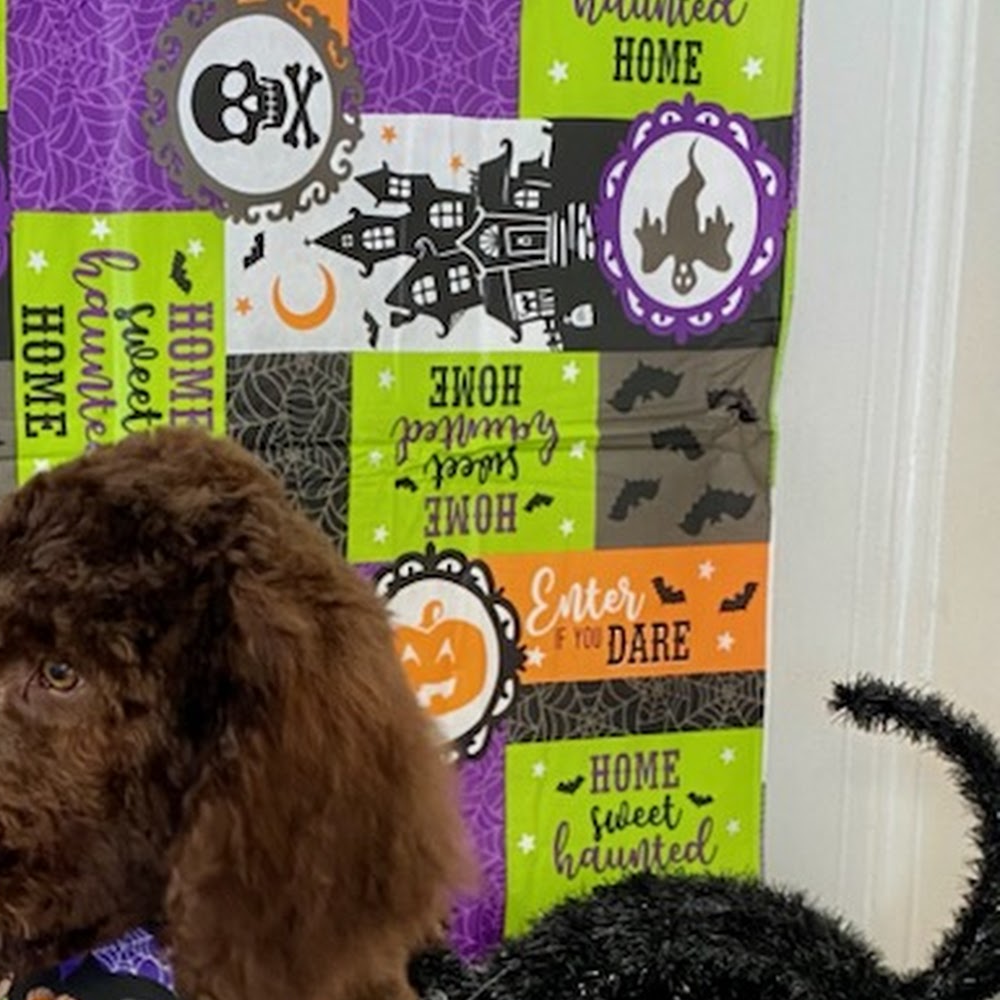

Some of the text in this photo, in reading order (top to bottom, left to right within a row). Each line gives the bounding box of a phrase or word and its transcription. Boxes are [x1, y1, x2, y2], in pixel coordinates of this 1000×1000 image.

[613, 36, 703, 86] HOME
[22, 304, 67, 439] HOME
[72, 248, 140, 448] haunte
[113, 302, 163, 434] sweet
[429, 364, 523, 408] HOME
[390, 410, 560, 466] haunted
[423, 445, 520, 490] sweet
[423, 493, 518, 538] HOME
[525, 565, 646, 637] Enter
[573, 625, 602, 650] YOU
[606, 620, 692, 665] DARE
[589, 748, 681, 795] HOME
[590, 794, 683, 842] sweet
[553, 815, 719, 881] haunted
